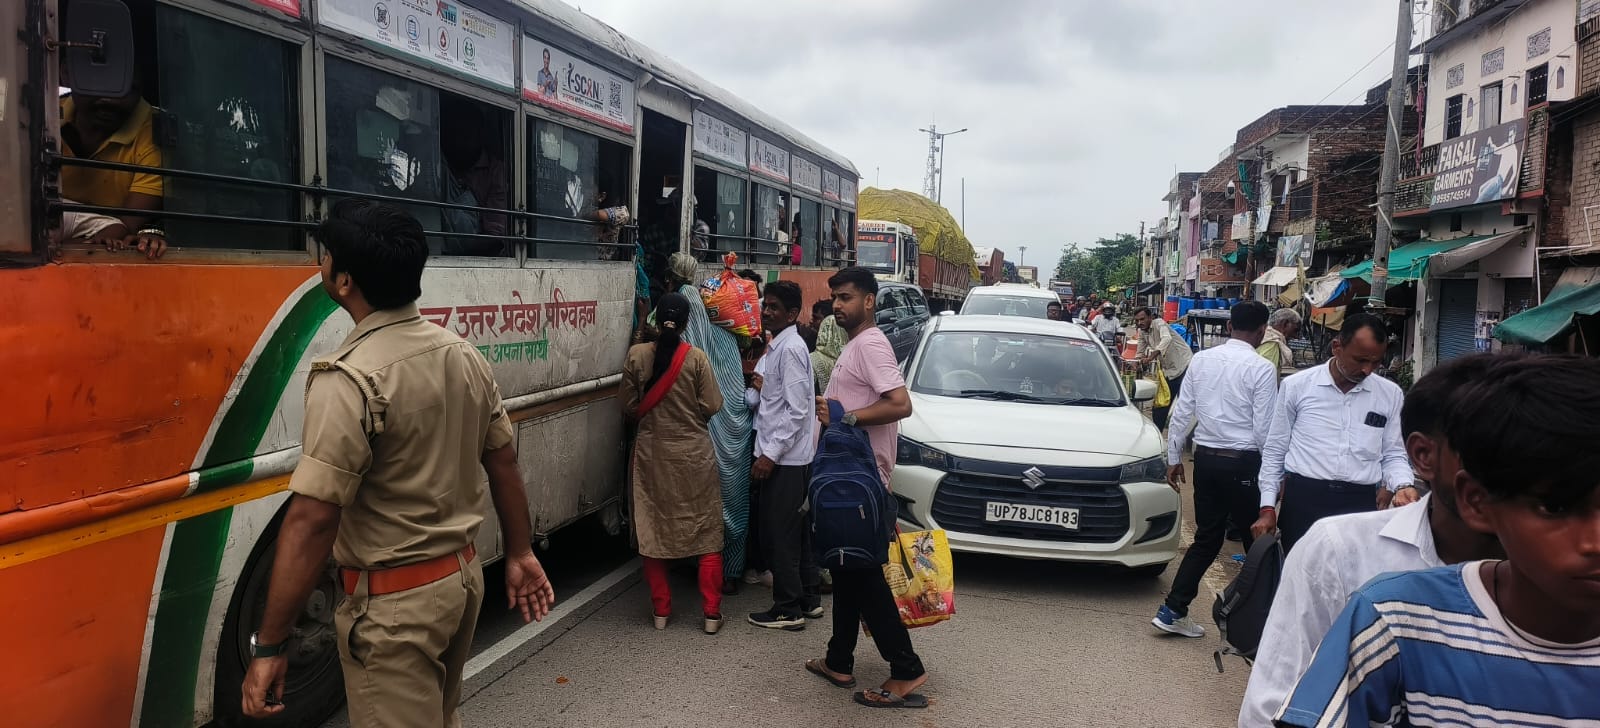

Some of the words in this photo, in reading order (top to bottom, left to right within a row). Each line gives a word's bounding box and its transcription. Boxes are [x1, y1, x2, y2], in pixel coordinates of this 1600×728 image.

[1438, 138, 1476, 172] FAISAL
[1434, 166, 1474, 192] GARMENTS
[455, 304, 499, 340] उत्तर
[499, 290, 542, 336] प्रदेश
[544, 287, 598, 336] परिवहन
[491, 342, 523, 363] अपना
[994, 504, 1078, 525] UP78JC8183
